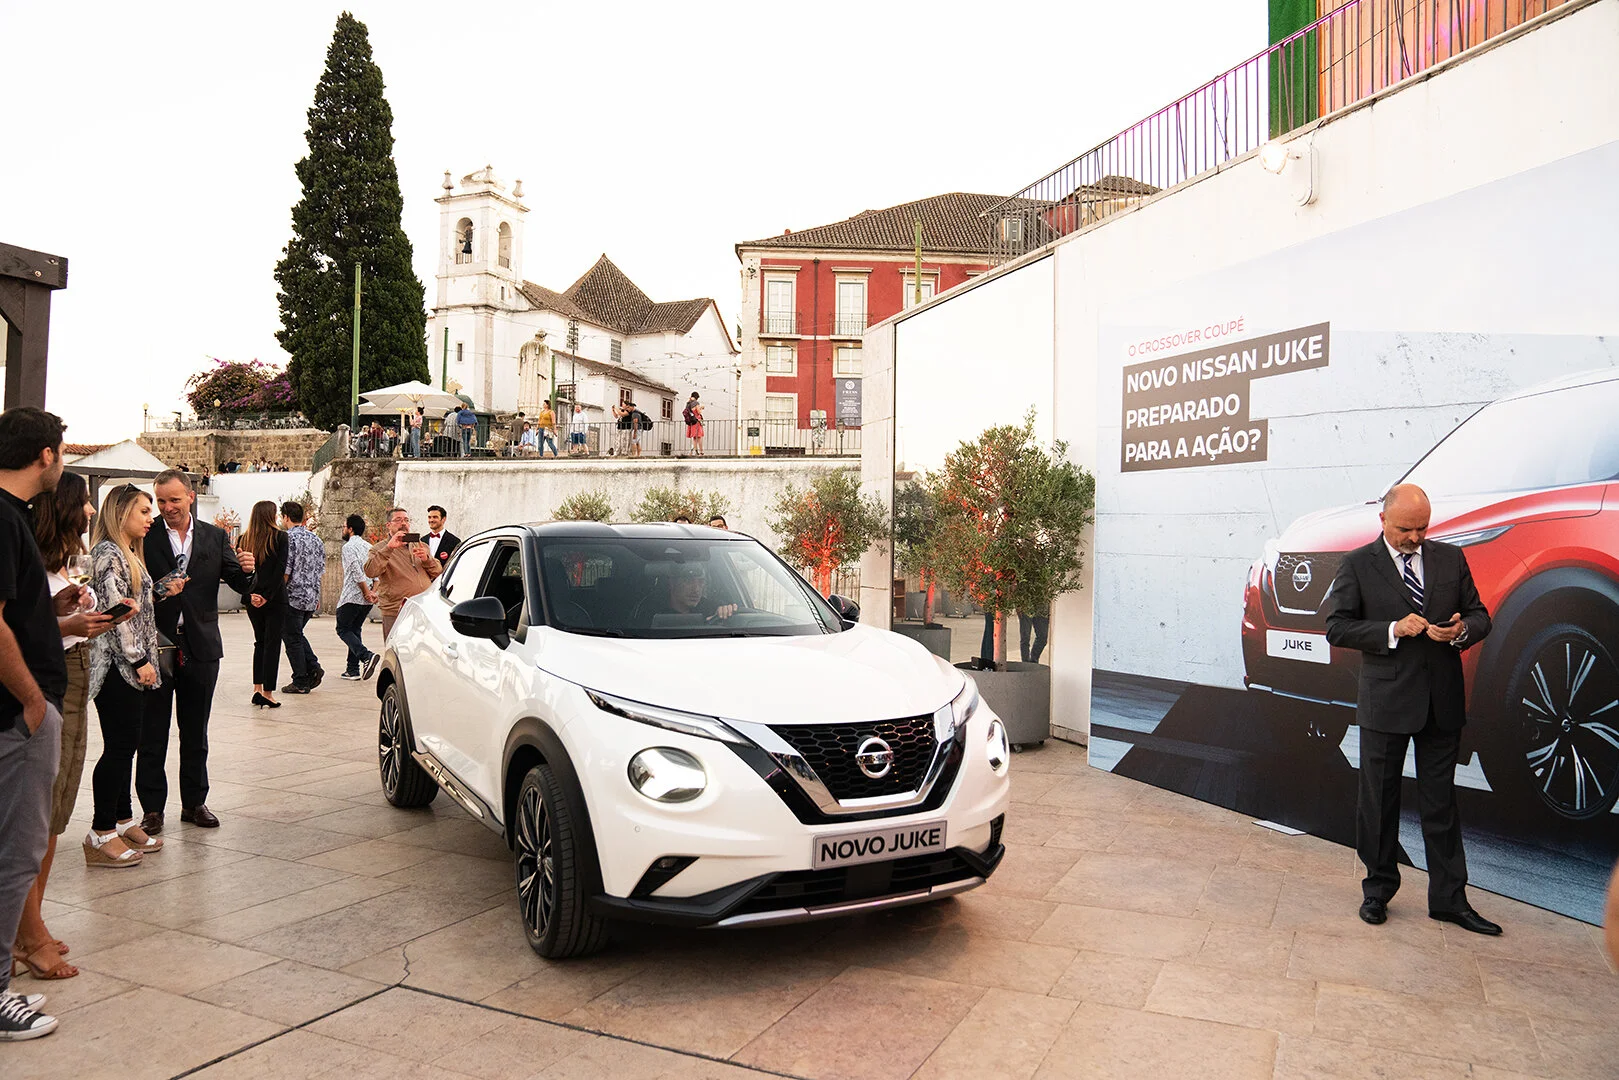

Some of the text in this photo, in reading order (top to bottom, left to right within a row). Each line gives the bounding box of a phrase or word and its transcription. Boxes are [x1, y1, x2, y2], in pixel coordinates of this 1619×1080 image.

[1128, 316, 1245, 357] O CROSSOVER COUPÉ
[1126, 334, 1324, 393] NOVO NISSAN JUKE
[1125, 393, 1240, 430] PREPARADO
[1125, 425, 1262, 463] PARA A AÇÃO?
[1282, 639, 1312, 651] JUKE
[821, 828, 941, 862] NOVO JUKE
